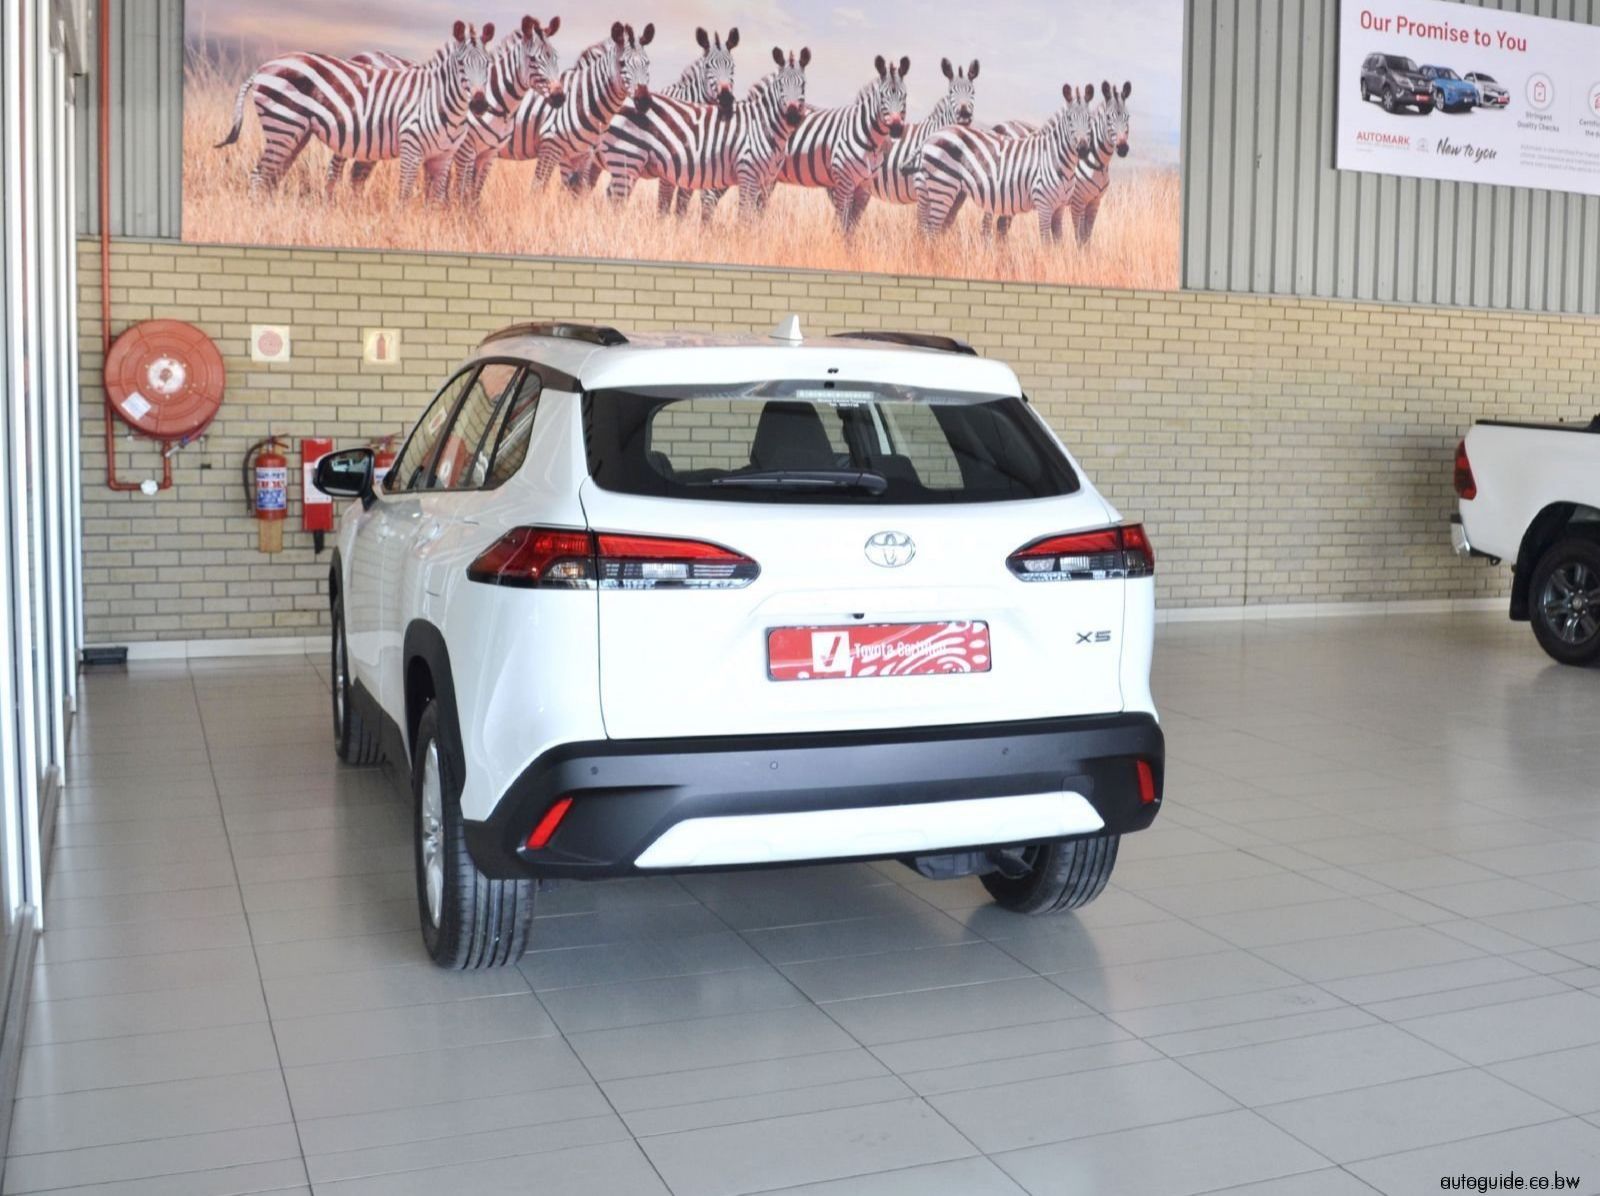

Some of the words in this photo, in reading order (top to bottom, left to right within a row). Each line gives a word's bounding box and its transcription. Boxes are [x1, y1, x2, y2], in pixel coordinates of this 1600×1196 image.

[1360, 10, 1391, 32] Our
[1396, 15, 1469, 43] Promise
[1474, 28, 1491, 47] to
[1496, 30, 1527, 52] You
[1356, 131, 1410, 145] AUTOMARK
[1463, 143, 1474, 156] to
[1474, 148, 1497, 163] you
[854, 642, 893, 659] Toyota
